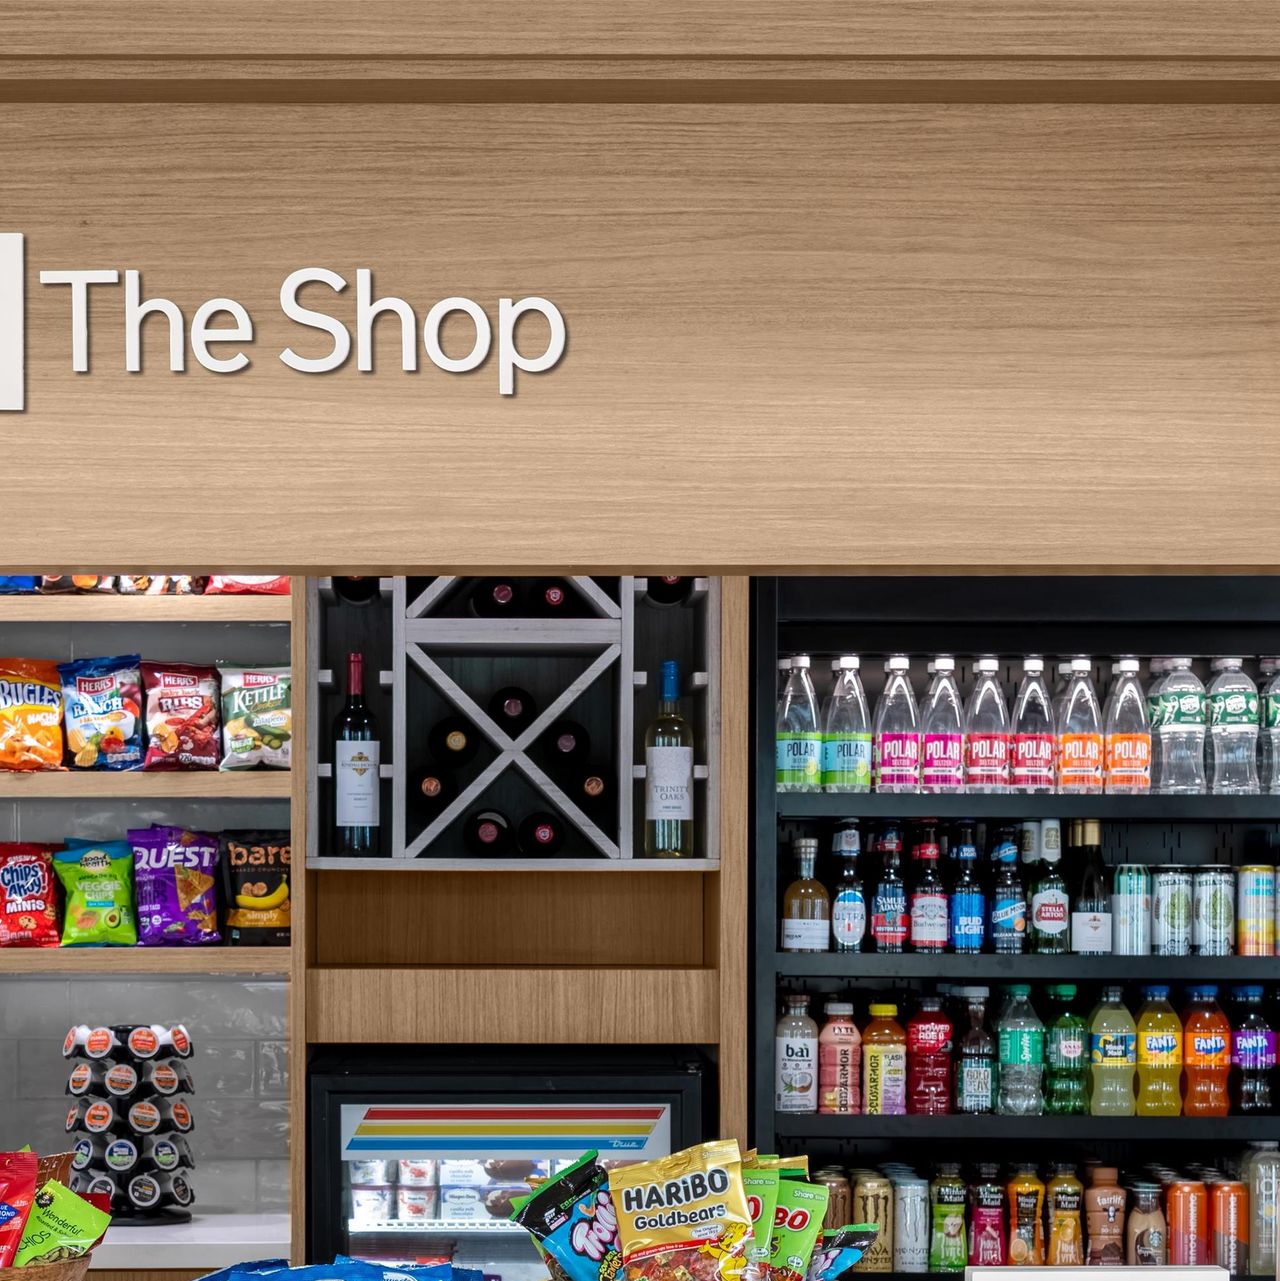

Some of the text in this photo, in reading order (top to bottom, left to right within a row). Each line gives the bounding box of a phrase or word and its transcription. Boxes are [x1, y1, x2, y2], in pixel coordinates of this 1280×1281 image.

[40, 267, 567, 396] The Shop
[159, 696, 204, 712] RIBS
[233, 686, 286, 713] KETTLE
[787, 742, 815, 757] POLAR
[837, 742, 865, 757] POLAR
[884, 740, 917, 759] POLAR
[926, 742, 959, 760] POLAR
[972, 742, 1006, 759] POLAR
[1018, 742, 1051, 759] POLAR
[1065, 742, 1098, 759] POLAR
[1115, 742, 1147, 759] POLAR
[654, 785, 689, 793] TRINITY
[660, 793, 685, 801] OAKS
[134, 846, 216, 869] QUEST
[228, 841, 291, 866] bare
[76, 881, 121, 891] VEGGIE
[85, 891, 114, 900] CHIPS
[876, 896, 907, 906] SAMUEL
[879, 903, 905, 913] ADAMS
[246, 911, 279, 922] simply
[834, 912, 865, 921] ULTRA
[913, 920, 947, 928] Budweiser
[959, 917, 982, 926] BUD
[954, 925, 984, 935] LIGHT
[1021, 1033, 1030, 1062] Sprite
[1145, 1036, 1177, 1050] FANTA
[1194, 1037, 1226, 1050] FANTA
[1236, 1035, 1268, 1049] FANTA
[786, 1042, 809, 1058] bai
[634, 1203, 727, 1232] Goldbears
